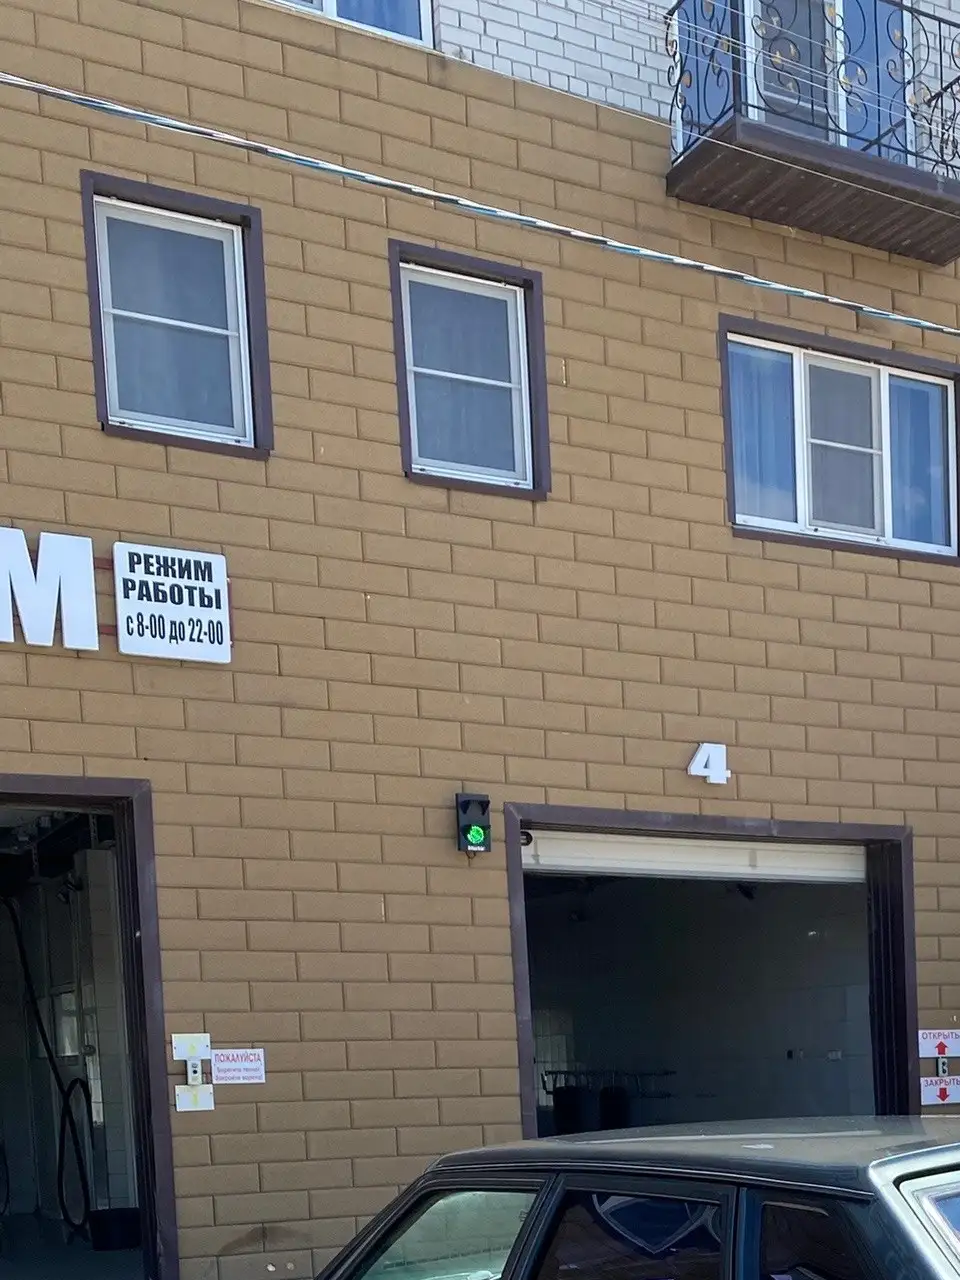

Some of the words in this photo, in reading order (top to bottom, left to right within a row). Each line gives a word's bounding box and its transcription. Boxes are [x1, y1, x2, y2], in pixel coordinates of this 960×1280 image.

[128, 551, 213, 582] РЕЖИМ
[122, 577, 222, 610] РАБОТЫ
[136, 611, 166, 640] 8-00
[169, 619, 186, 645] до
[188, 617, 223, 646] 22-00
[687, 742, 731, 784] 4
[921, 1031, 960, 1040] ОТКРЫТЬ
[214, 1050, 262, 1063] ПОЖАЛУЙСТА
